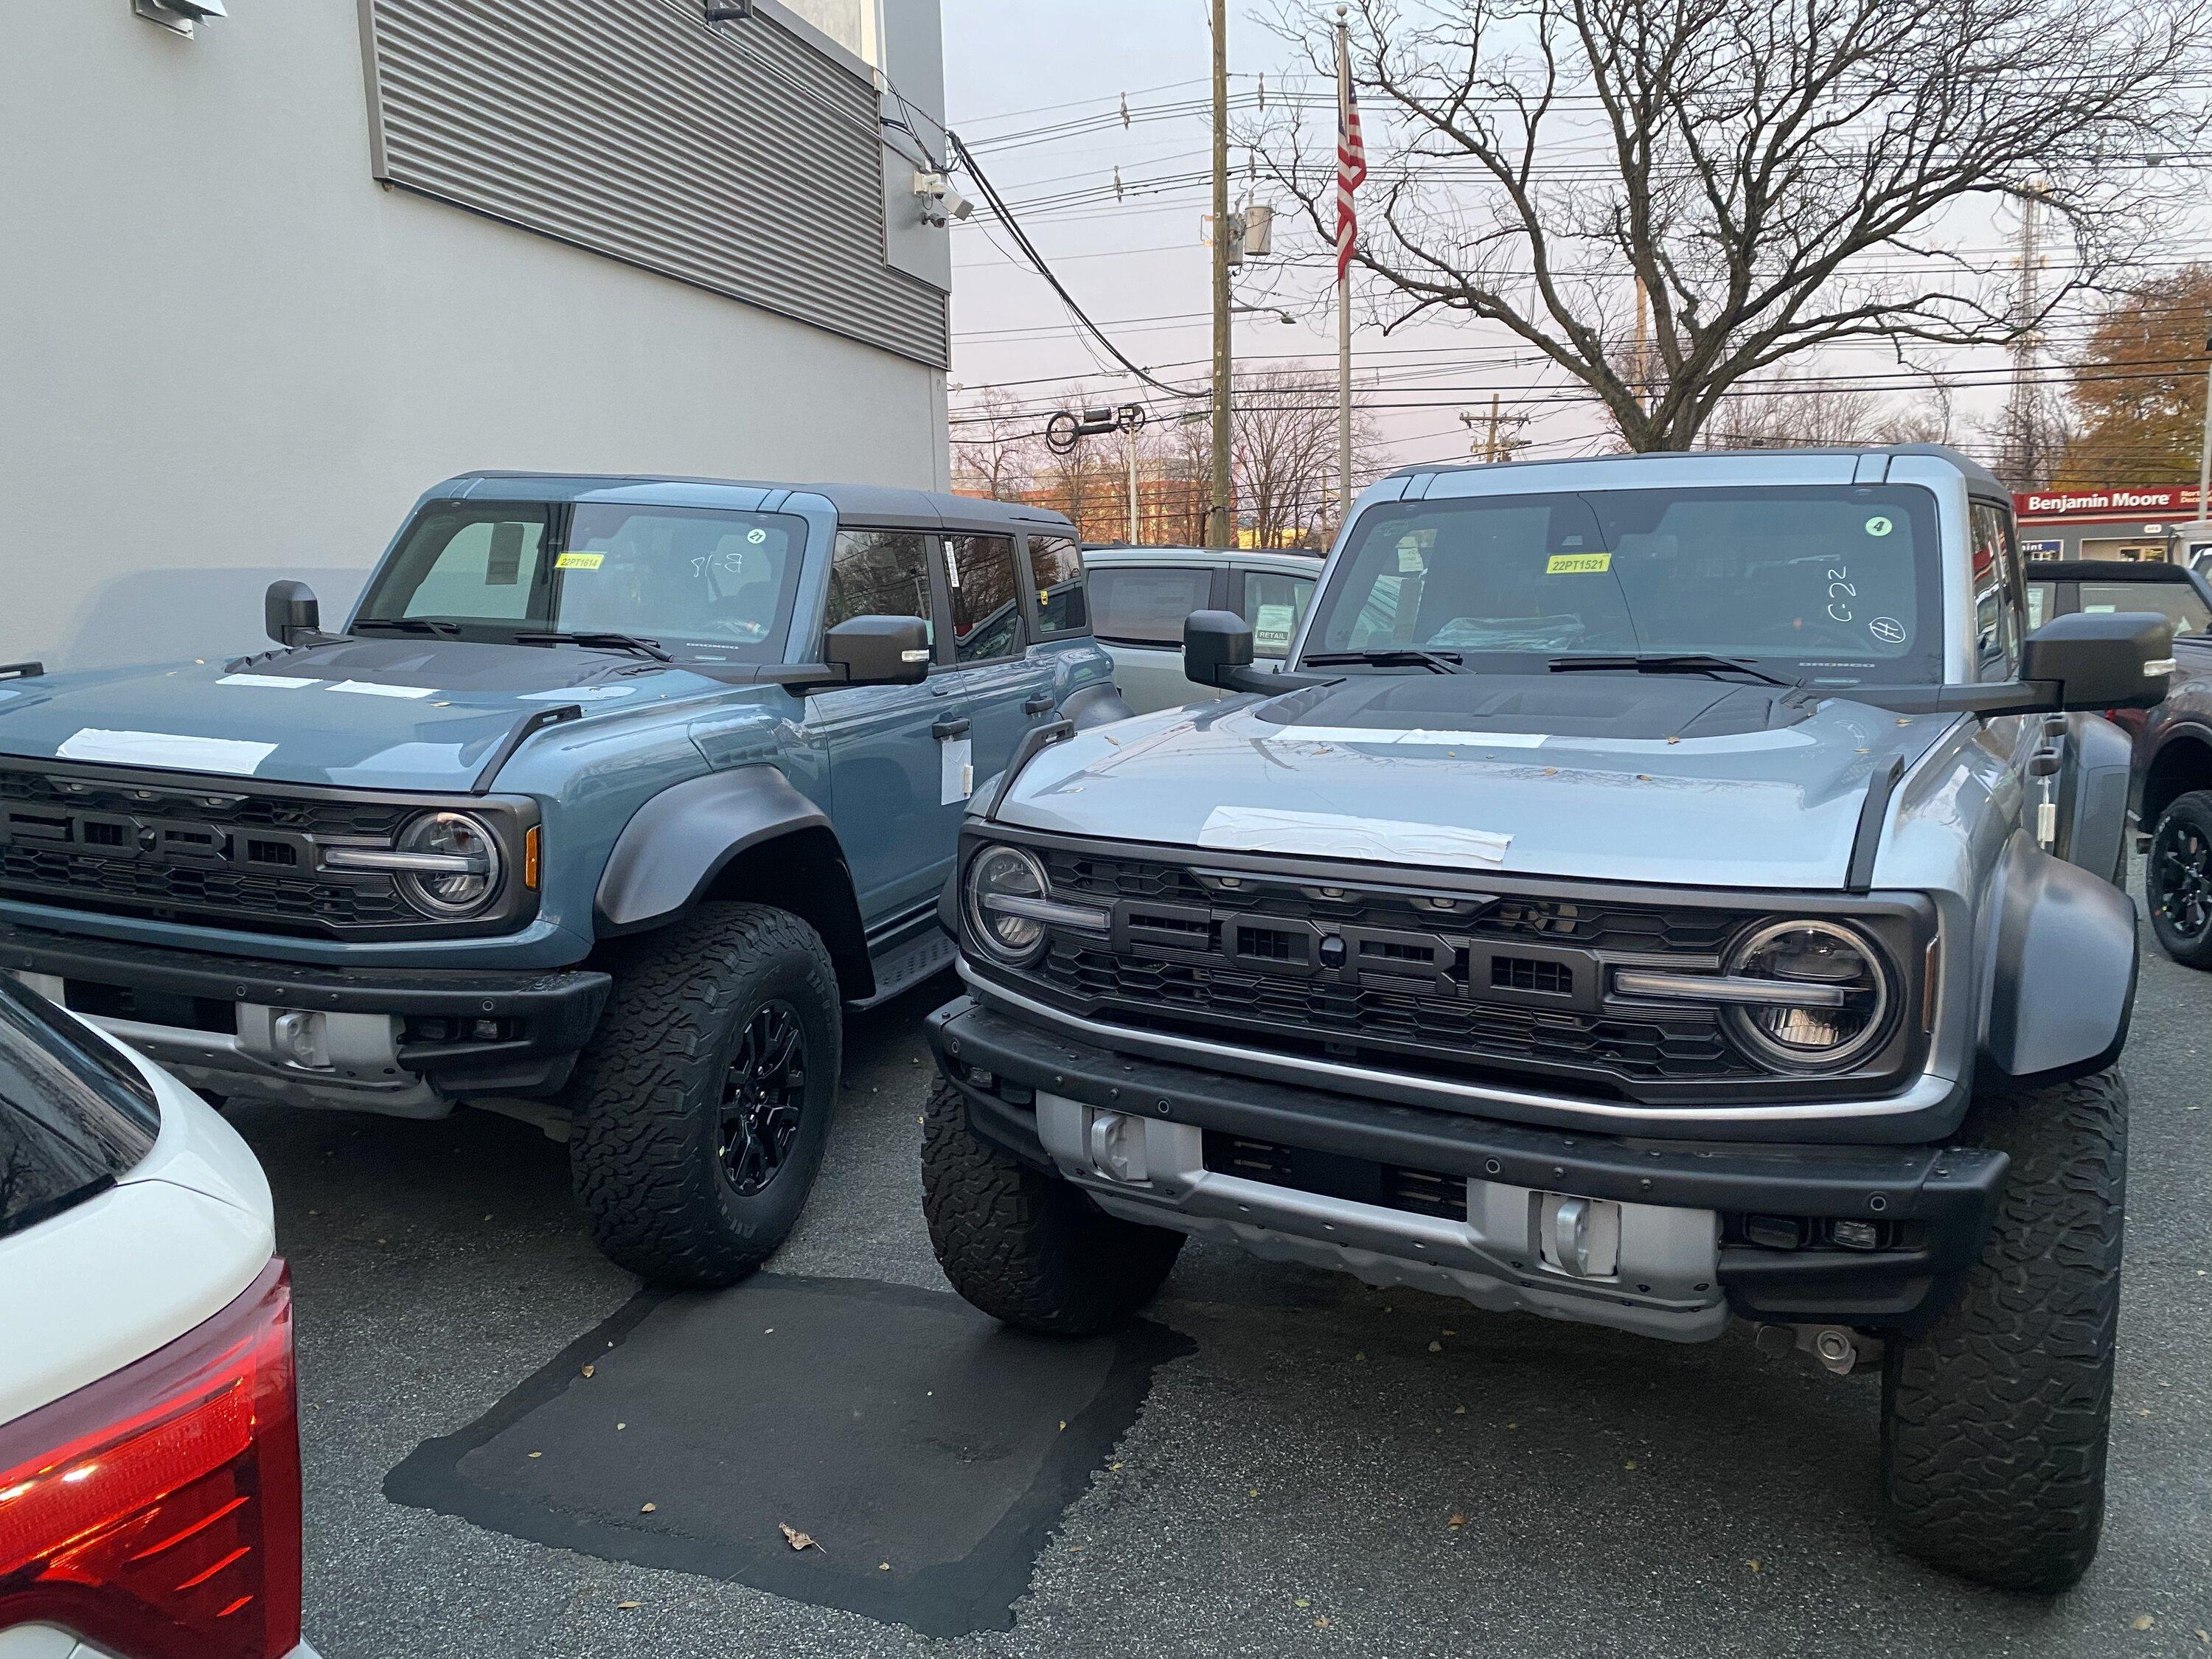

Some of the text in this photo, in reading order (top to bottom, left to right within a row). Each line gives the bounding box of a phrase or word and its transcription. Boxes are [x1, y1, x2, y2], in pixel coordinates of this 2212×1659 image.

[2028, 492, 2169, 513] Benjamin Moore
[1873, 521, 1885, 532] 4
[749, 531, 764, 543] 21
[1552, 560, 1604, 571] 22PT1521
[1259, 631, 1286, 640] RETAIL
[0, 801, 317, 878] FORD
[1111, 897, 1603, 1015] FORD
